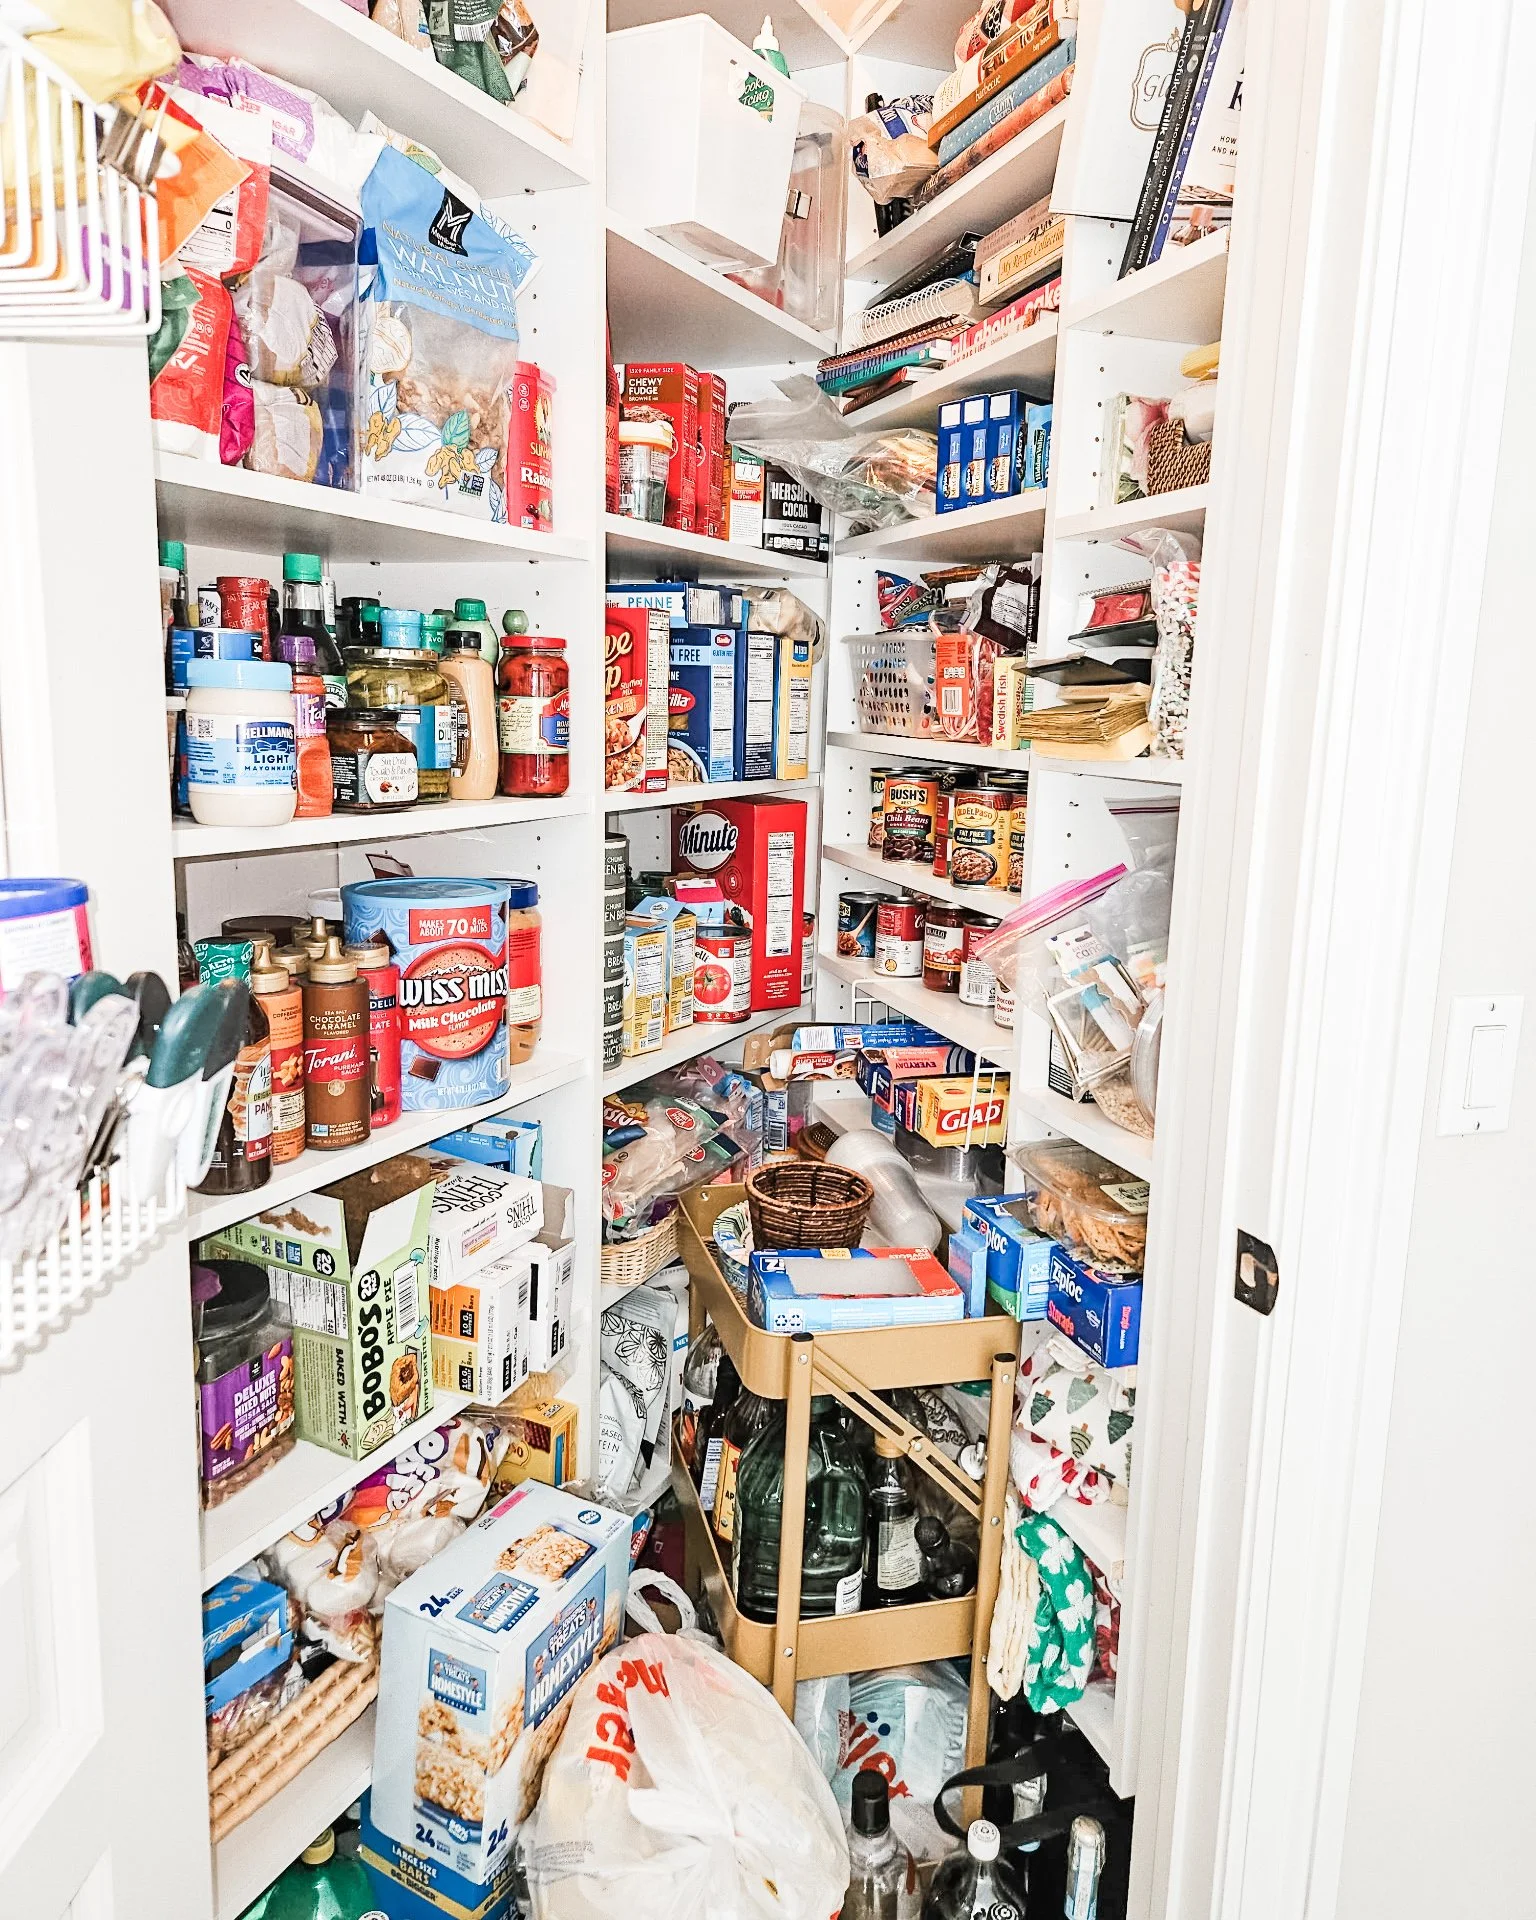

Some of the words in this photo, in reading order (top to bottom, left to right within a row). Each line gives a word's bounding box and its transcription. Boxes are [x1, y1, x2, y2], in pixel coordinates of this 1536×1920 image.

[1170, 18, 1195, 100] momofuku
[1160, 103, 1173, 136] milk
[1147, 212, 1155, 231] AND
[1166, 120, 1180, 162] COMFORT
[1179, 79, 1193, 119] COOKING
[1152, 141, 1165, 166] bar
[1161, 171, 1183, 225] KETO
[474, 294, 499, 310] AND
[973, 309, 1017, 348] about
[628, 377, 663, 387] CHEWY
[629, 387, 659, 396] FUDGE
[1034, 454, 1043, 480] Hidden
[782, 502, 809, 519] COCOA
[627, 596, 673, 609] PENNE
[678, 650, 701, 662] FREE
[996, 674, 1007, 694] Fish
[995, 698, 1007, 742] Swedish
[253, 754, 289, 765] LIGHT
[890, 788, 926, 801] BUSH'S
[886, 814, 903, 823] Chili
[904, 814, 929, 824] Beans
[679, 823, 738, 857] Minute
[969, 830, 986, 838] FREE
[419, 919, 444, 929] MAKES
[447, 918, 469, 936] 70
[420, 928, 444, 937] ABOUT
[470, 924, 488, 934] MUGS
[400, 976, 465, 1007] WISS
[310, 1012, 361, 1023] CHOCOLATE
[314, 1021, 357, 1031] CARAMEL
[409, 1016, 440, 1033] Milk
[440, 998, 497, 1027] Chocolate
[448, 1020, 470, 1031] FLAVOR
[304, 1044, 357, 1074] Torani
[895, 1061, 937, 1070] EVERYDAY
[941, 1104, 1001, 1131] GLAD
[459, 1188, 503, 1213] GOOD
[506, 1196, 538, 1224] THINS
[513, 1214, 531, 1229] GOOD
[320, 1254, 333, 1275] 20
[360, 1275, 372, 1300] 20
[384, 1277, 393, 1303] PIE
[1051, 1260, 1084, 1303] Ziploc
[386, 1305, 395, 1345] APPLE
[1048, 1300, 1075, 1337] Storage
[335, 1347, 345, 1387] BAKED
[358, 1303, 386, 1421] BOBO'S
[235, 1369, 276, 1408] DELUXE
[235, 1394, 259, 1418] MIXED
[259, 1382, 277, 1403] NUTS
[261, 1394, 277, 1411] SALT
[338, 1390, 348, 1426] WITH
[601, 1428, 623, 1442] BASED
[419, 1594, 451, 1618] 24
[529, 1613, 602, 1717] HOMESTYLE
[430, 1675, 484, 1710] HOMESTYLE
[415, 1823, 436, 1848] 24
[486, 1816, 509, 1858] 24
[392, 1844, 418, 1868] LARGE
[419, 1862, 438, 1879] SIZE
[399, 1859, 430, 1885] BARS
